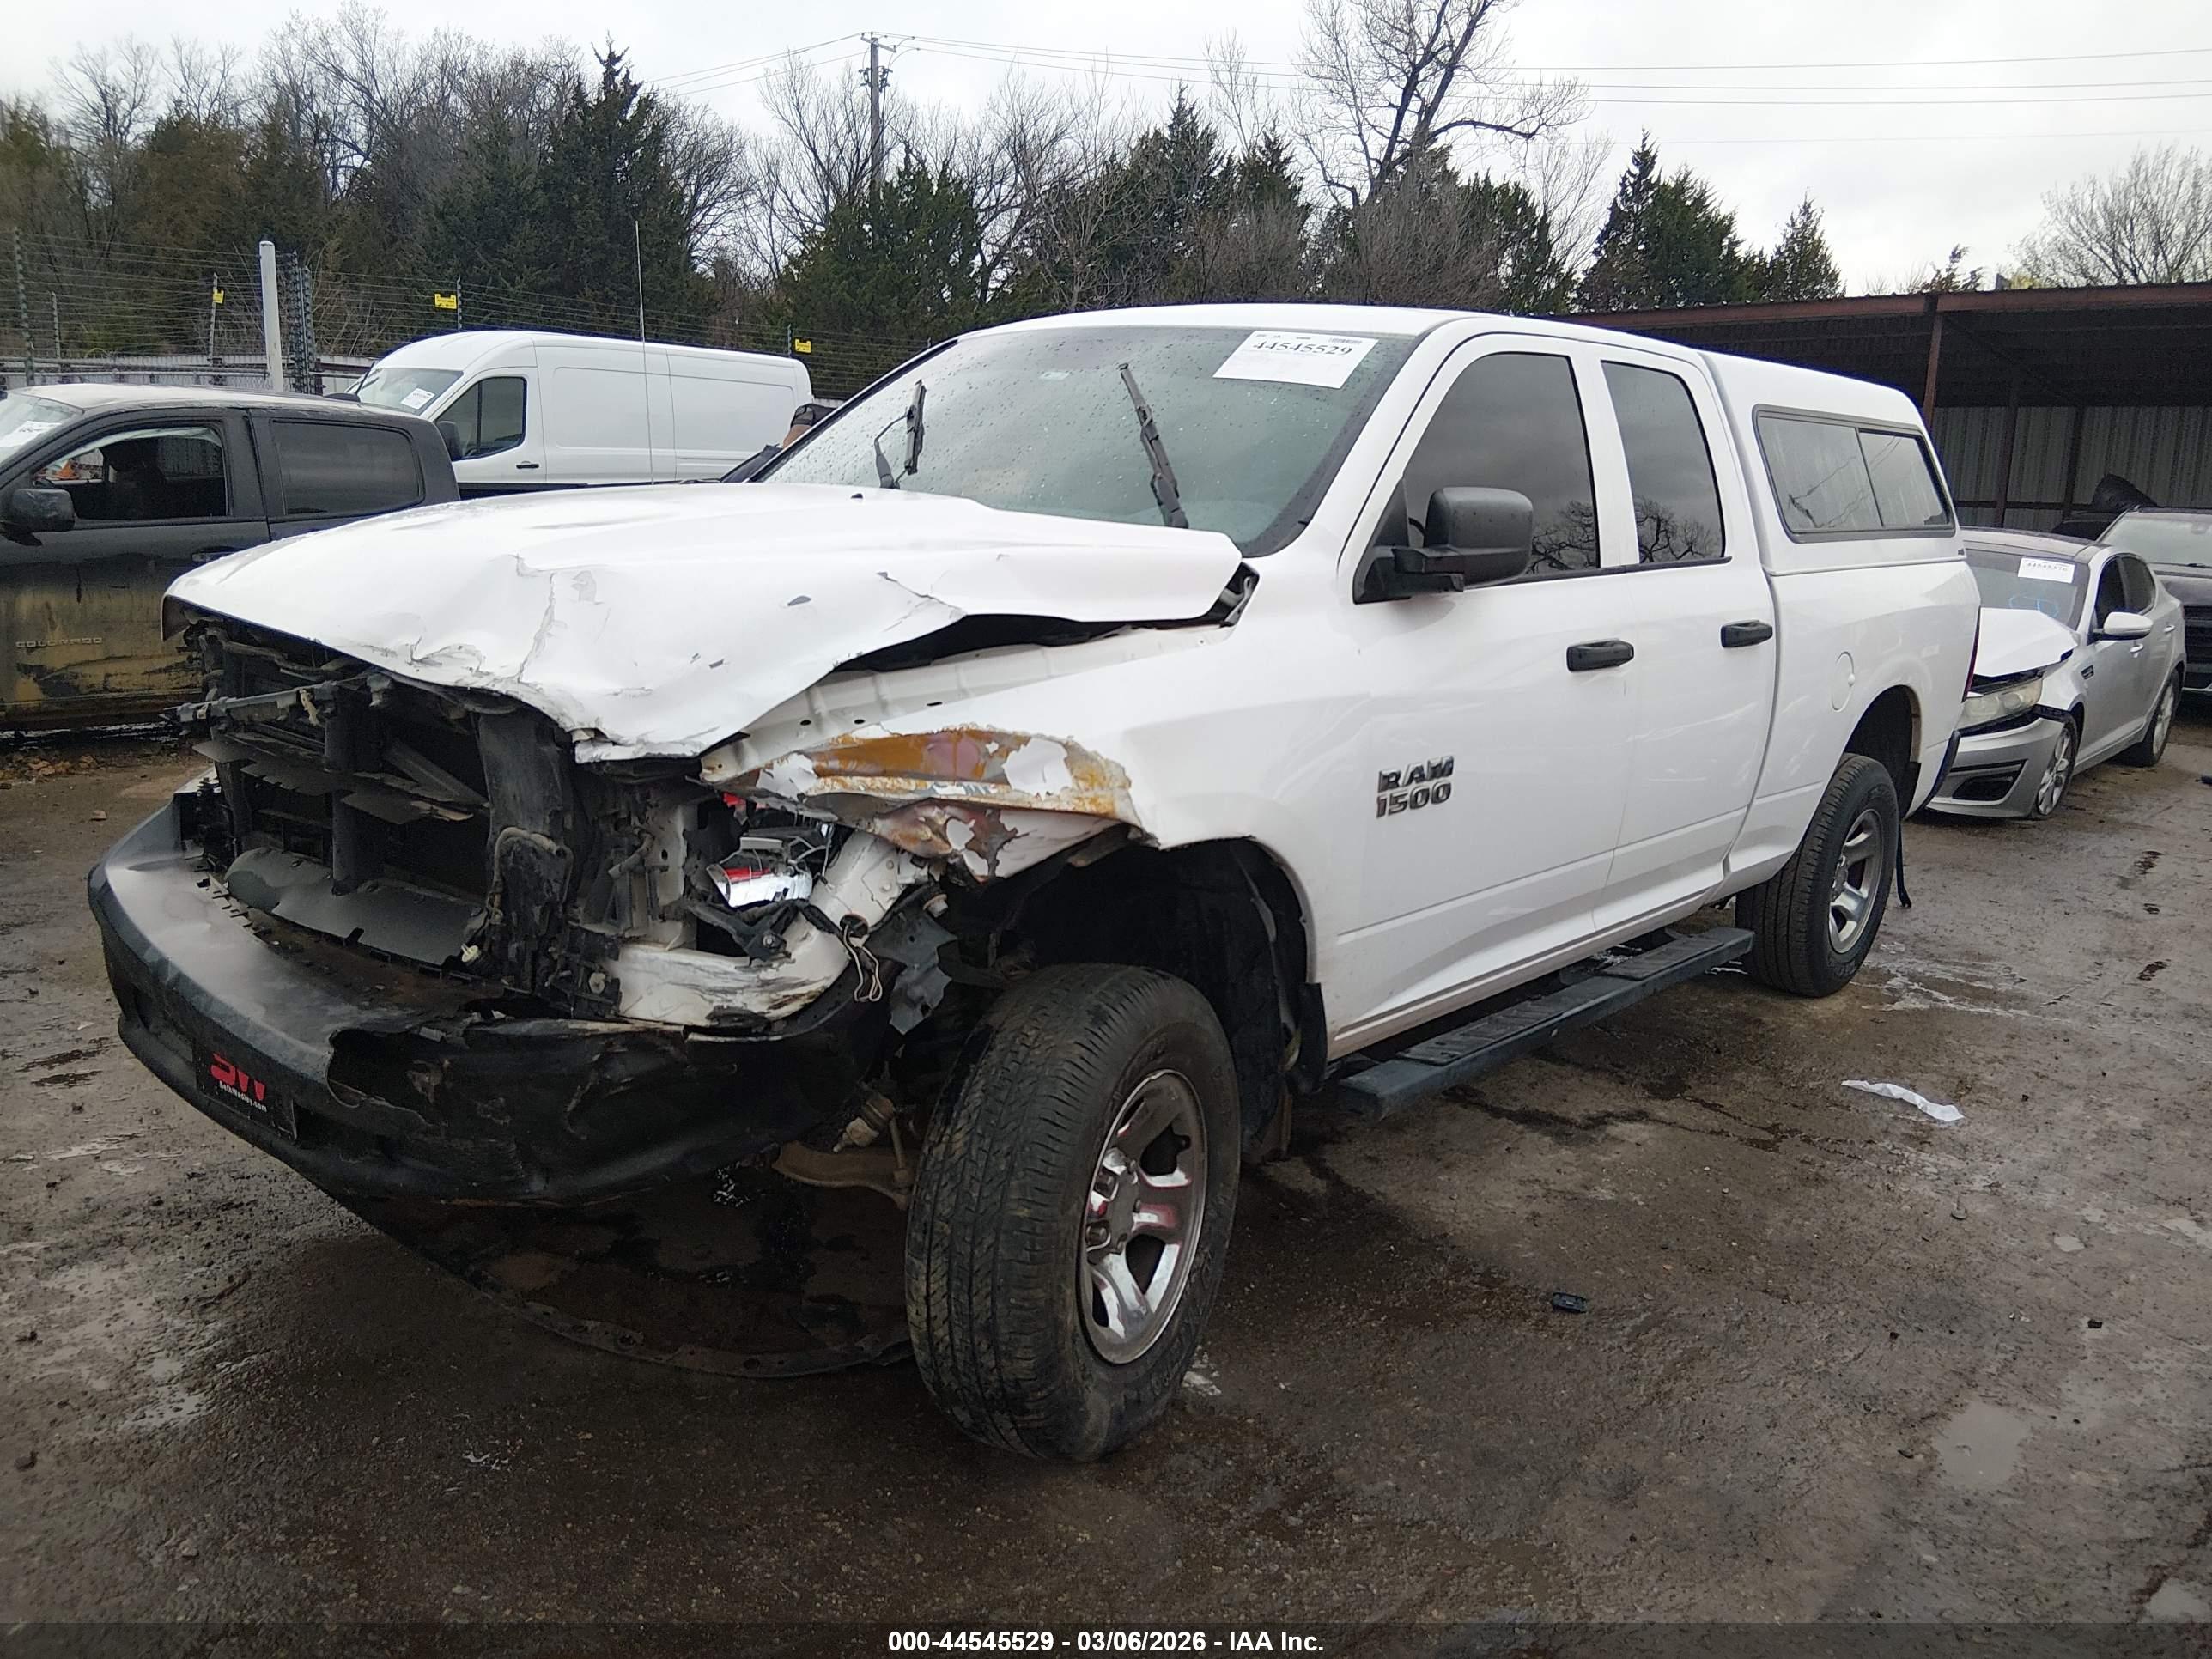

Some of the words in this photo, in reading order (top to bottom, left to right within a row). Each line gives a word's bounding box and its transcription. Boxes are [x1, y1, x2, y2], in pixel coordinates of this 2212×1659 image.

[1253, 341, 1352, 356] 44545529
[15, 637, 102, 648] COLORADO
[1377, 756, 1454, 793] RAM
[1376, 781, 1452, 818] 1500
